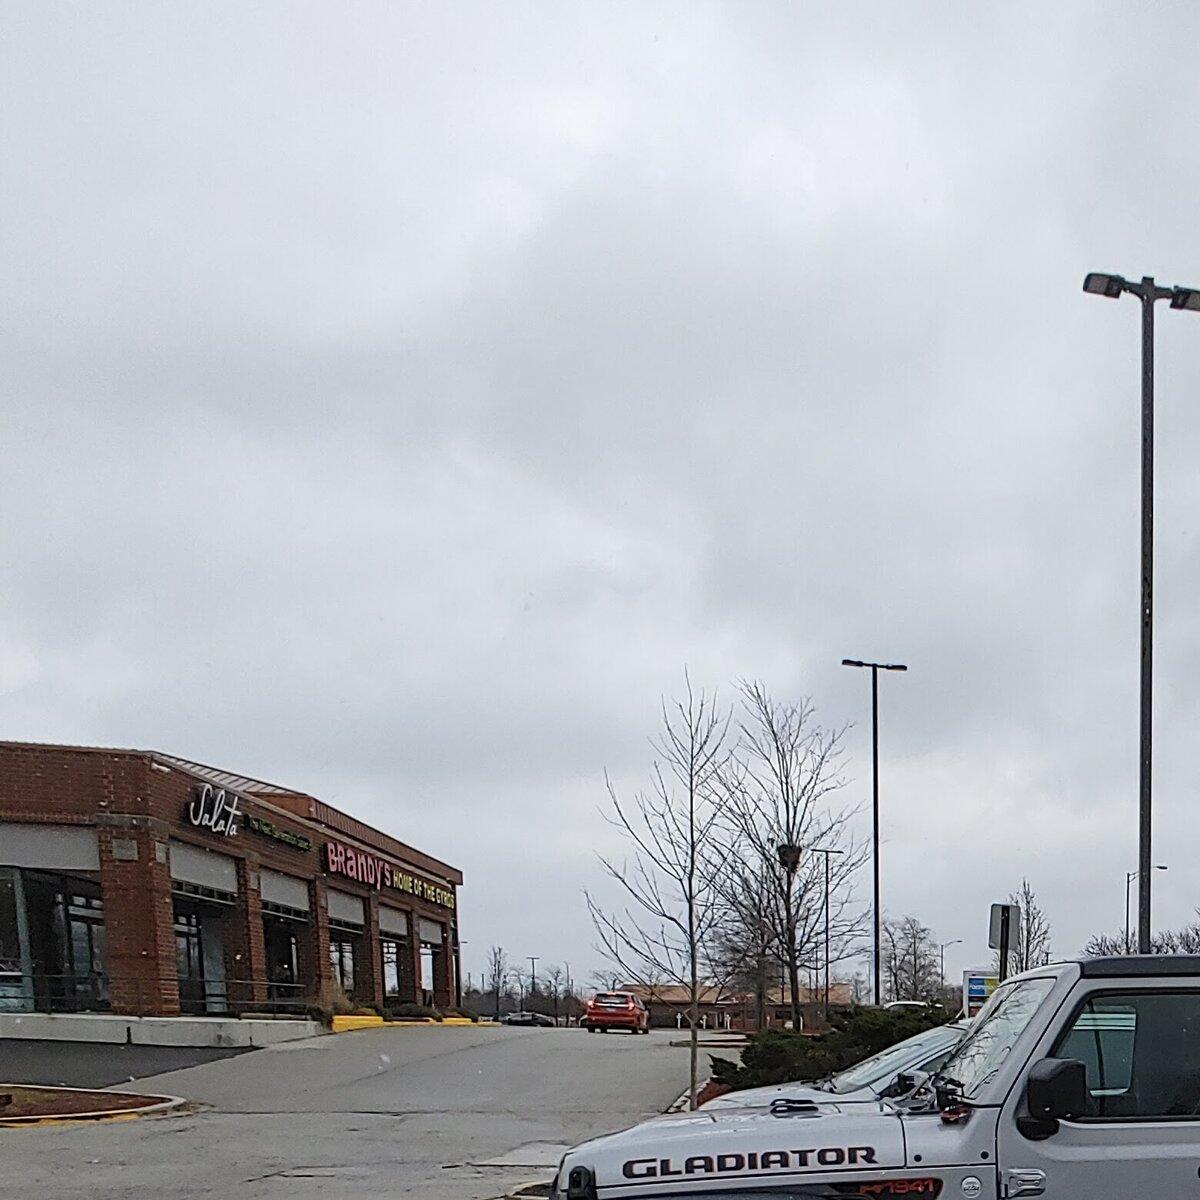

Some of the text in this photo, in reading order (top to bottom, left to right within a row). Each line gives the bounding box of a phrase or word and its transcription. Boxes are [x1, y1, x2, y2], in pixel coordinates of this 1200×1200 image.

[190, 783, 242, 836] Salata
[393, 869, 413, 893] HOME
[414, 878, 422, 897] OF
[423, 882, 436, 902] THE
[436, 888, 455, 909] GYROS
[622, 1146, 879, 1179] GLADIATOR
[885, 1178, 934, 1194] 1941
